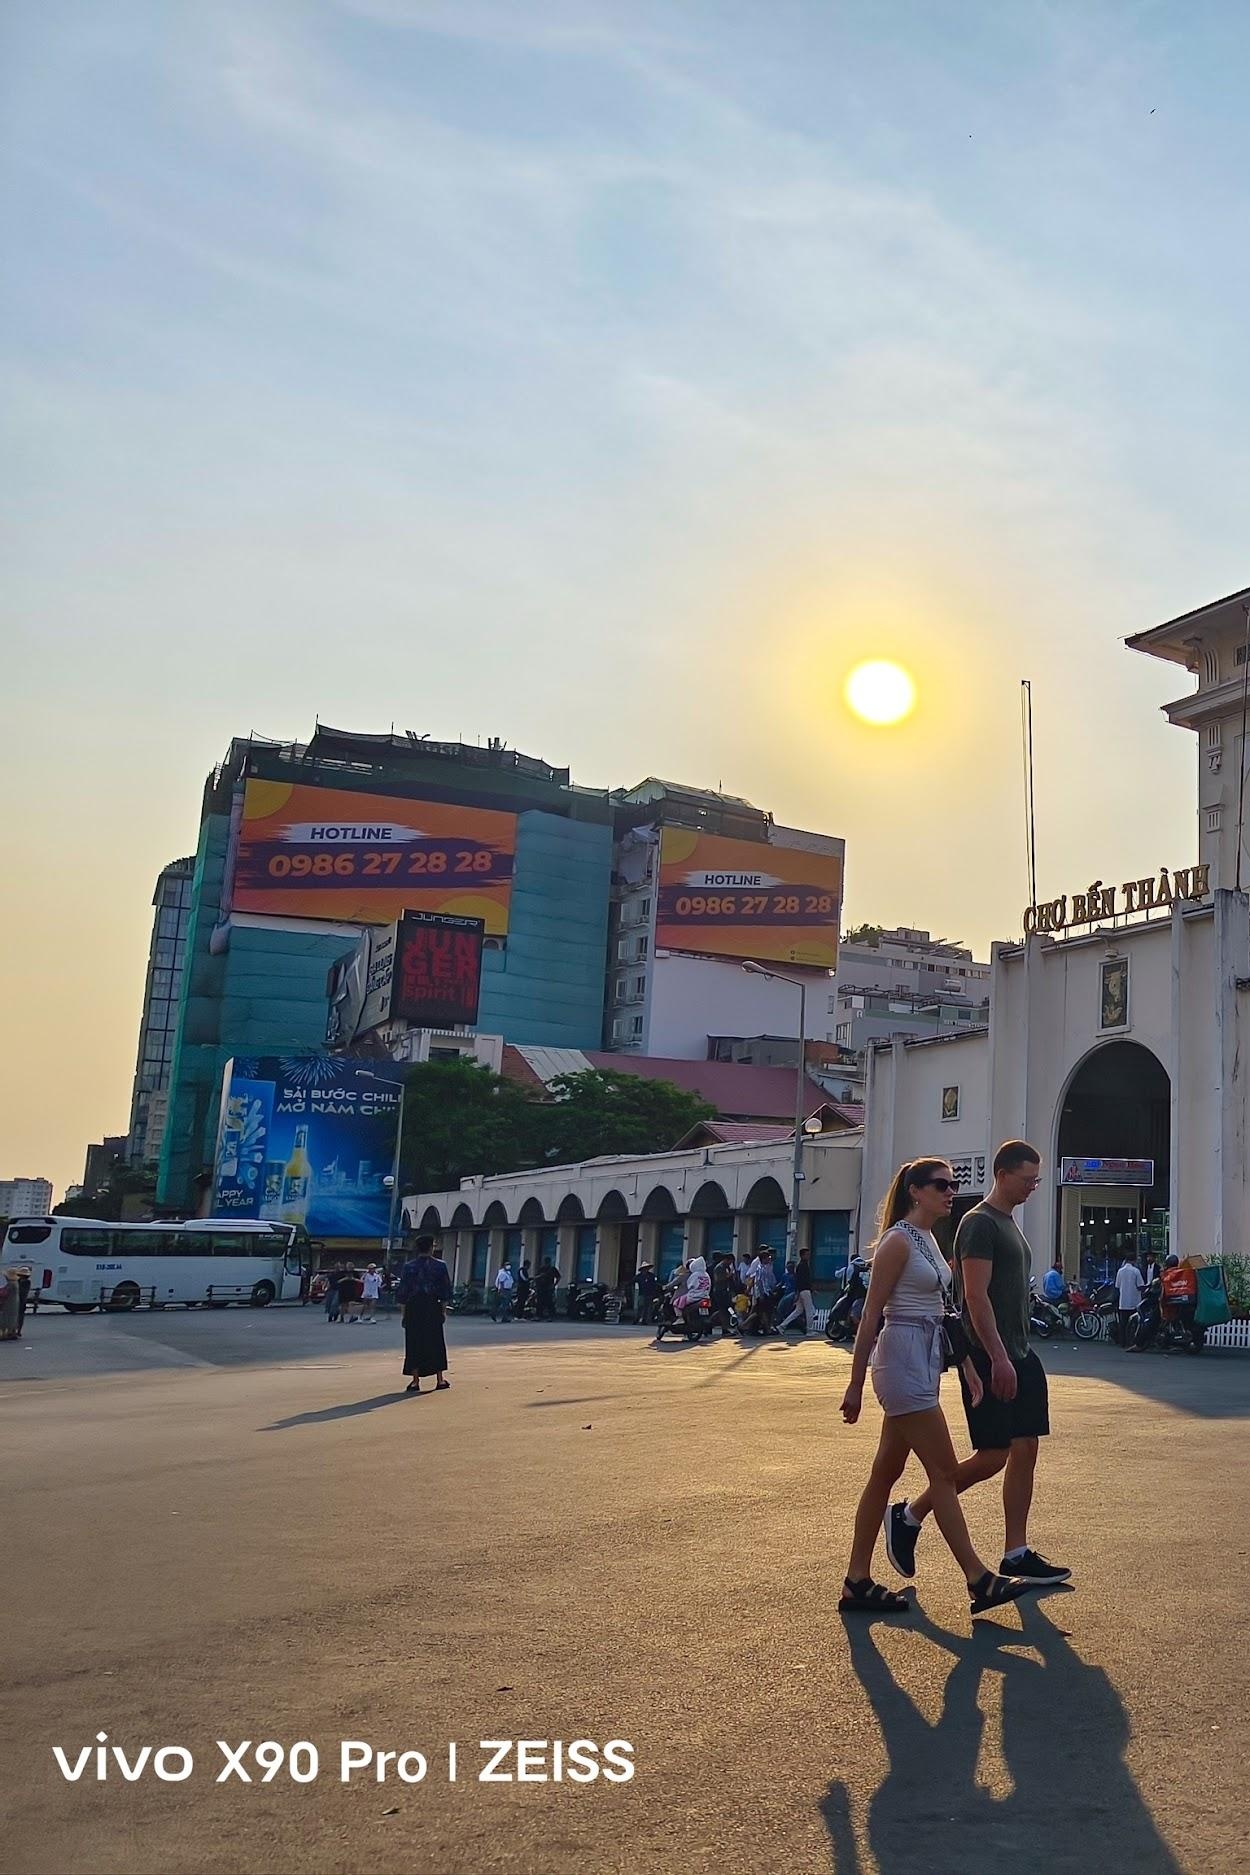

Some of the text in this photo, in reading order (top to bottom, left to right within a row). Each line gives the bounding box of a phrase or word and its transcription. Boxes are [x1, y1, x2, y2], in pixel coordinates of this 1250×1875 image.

[310, 826, 393, 841] HOTLINE
[268, 850, 493, 878] 0986 27 28 28
[704, 874, 762, 886] HOTLINE
[675, 895, 832, 916] 0986 27 28 28
[1023, 863, 1211, 934] CHỢ BẾN THÀNH
[411, 912, 479, 928] JUNGER
[283, 1085, 307, 1099] SẢI
[310, 1087, 357, 1101] BƯỚC
[311, 1101, 355, 1115] NĂM
